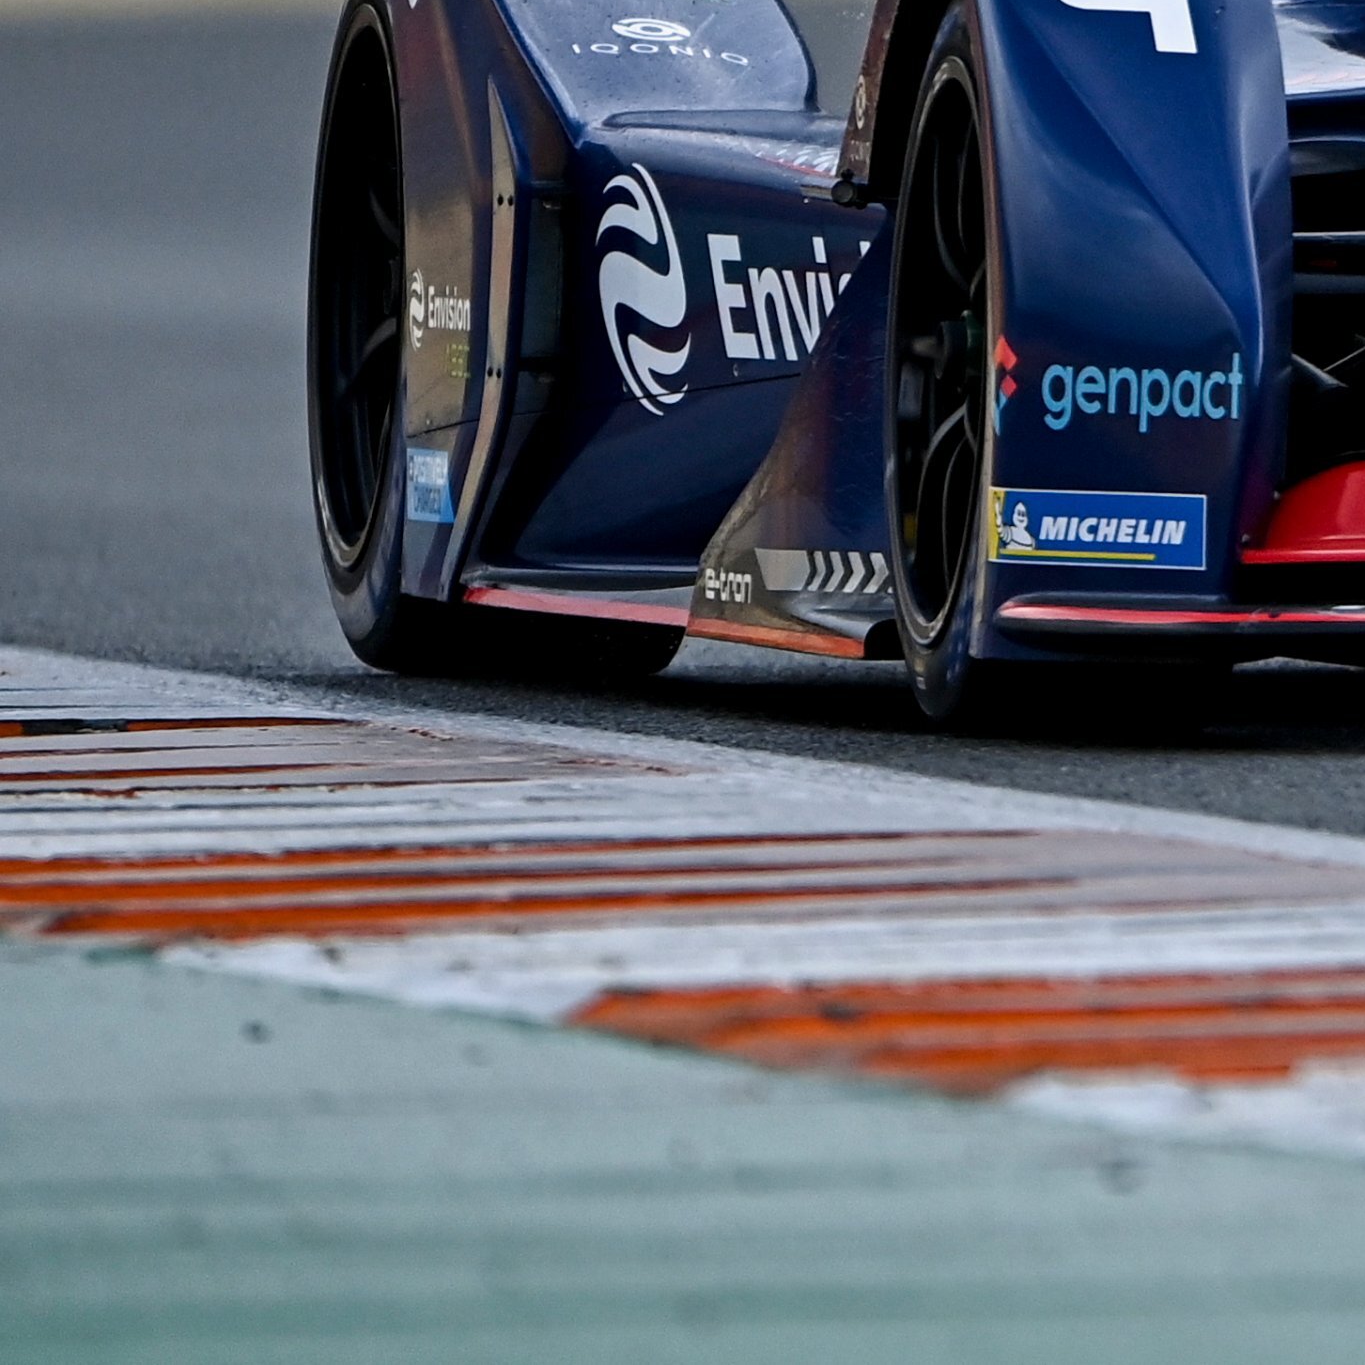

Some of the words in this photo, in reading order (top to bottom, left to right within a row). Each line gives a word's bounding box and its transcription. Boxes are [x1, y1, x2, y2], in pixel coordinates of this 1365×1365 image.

[427, 284, 471, 332] Envision
[1041, 352, 1245, 433] genpact
[1039, 514, 1187, 546] MICHELIN
[705, 566, 752, 604] e-tron
